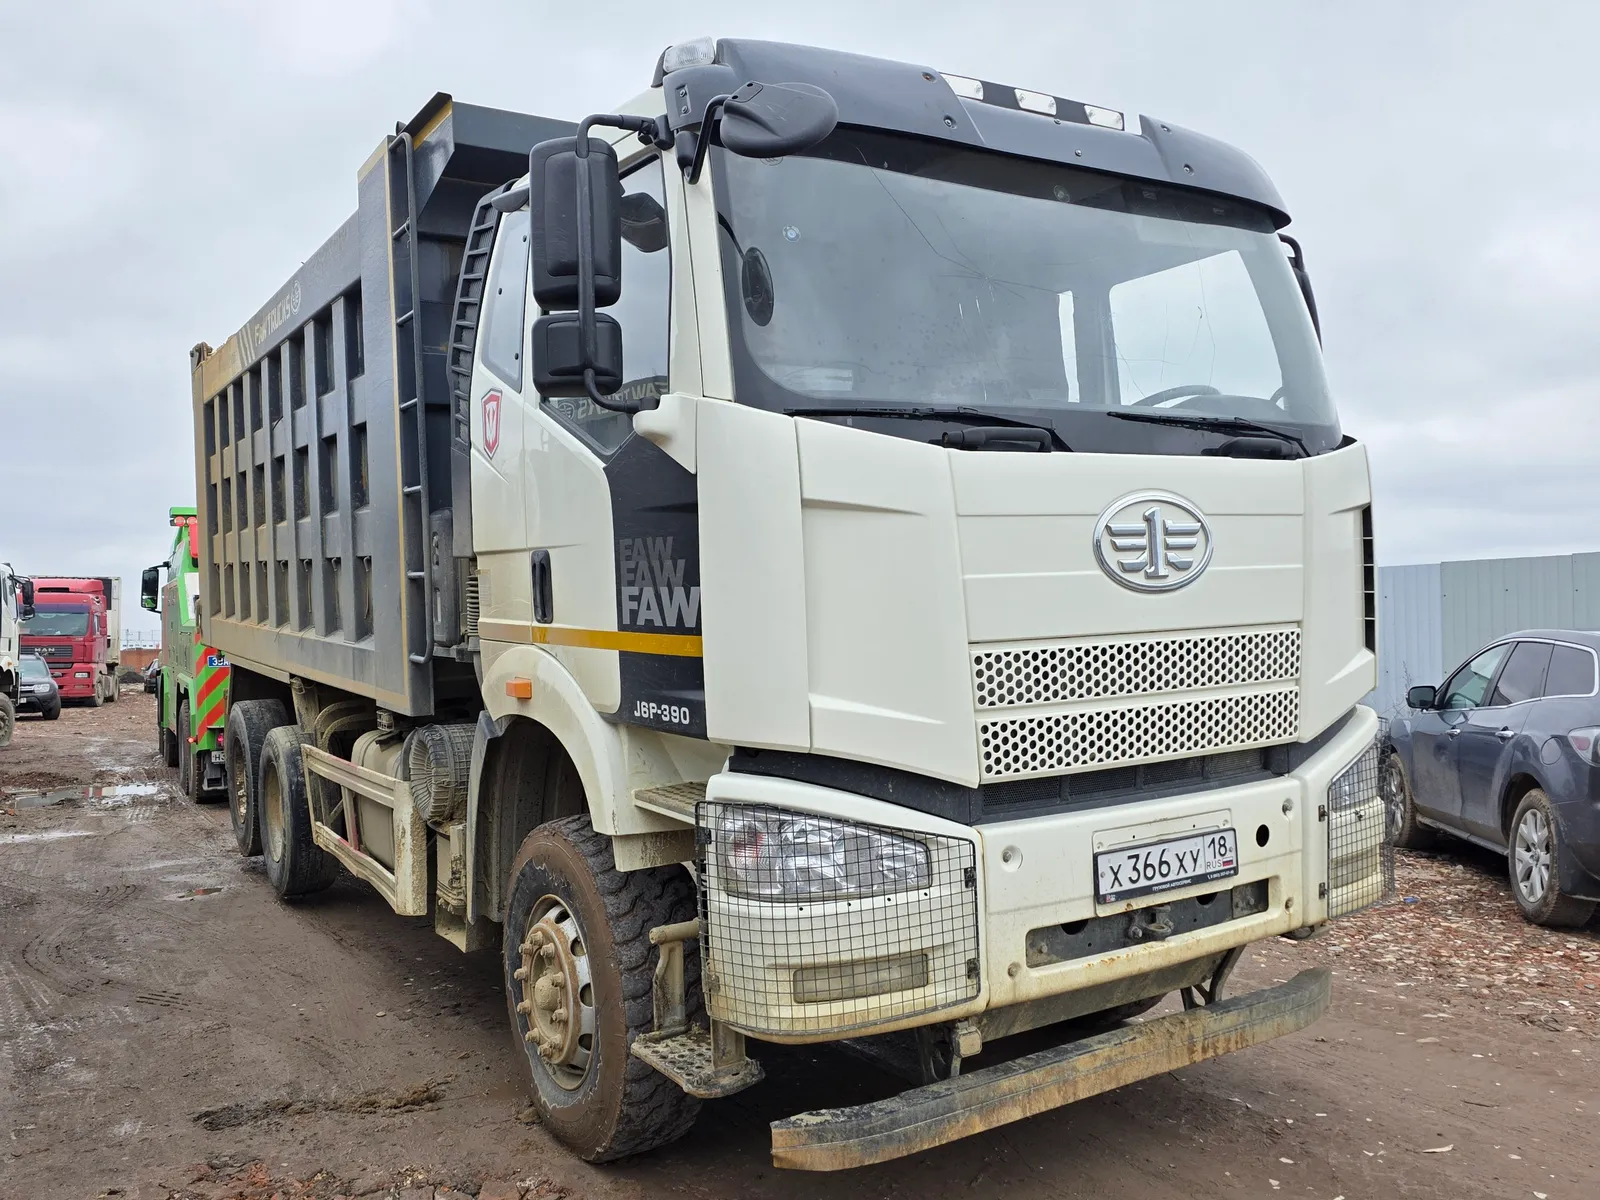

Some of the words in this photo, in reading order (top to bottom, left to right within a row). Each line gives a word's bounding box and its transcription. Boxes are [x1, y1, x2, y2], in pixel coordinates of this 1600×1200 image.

[619, 536, 673, 561] FAW
[620, 558, 686, 593] FAW
[621, 586, 701, 627] FAW
[634, 700, 690, 725] J6P-390
[1208, 835, 1228, 860] 18
[1206, 859, 1222, 870] RUS
